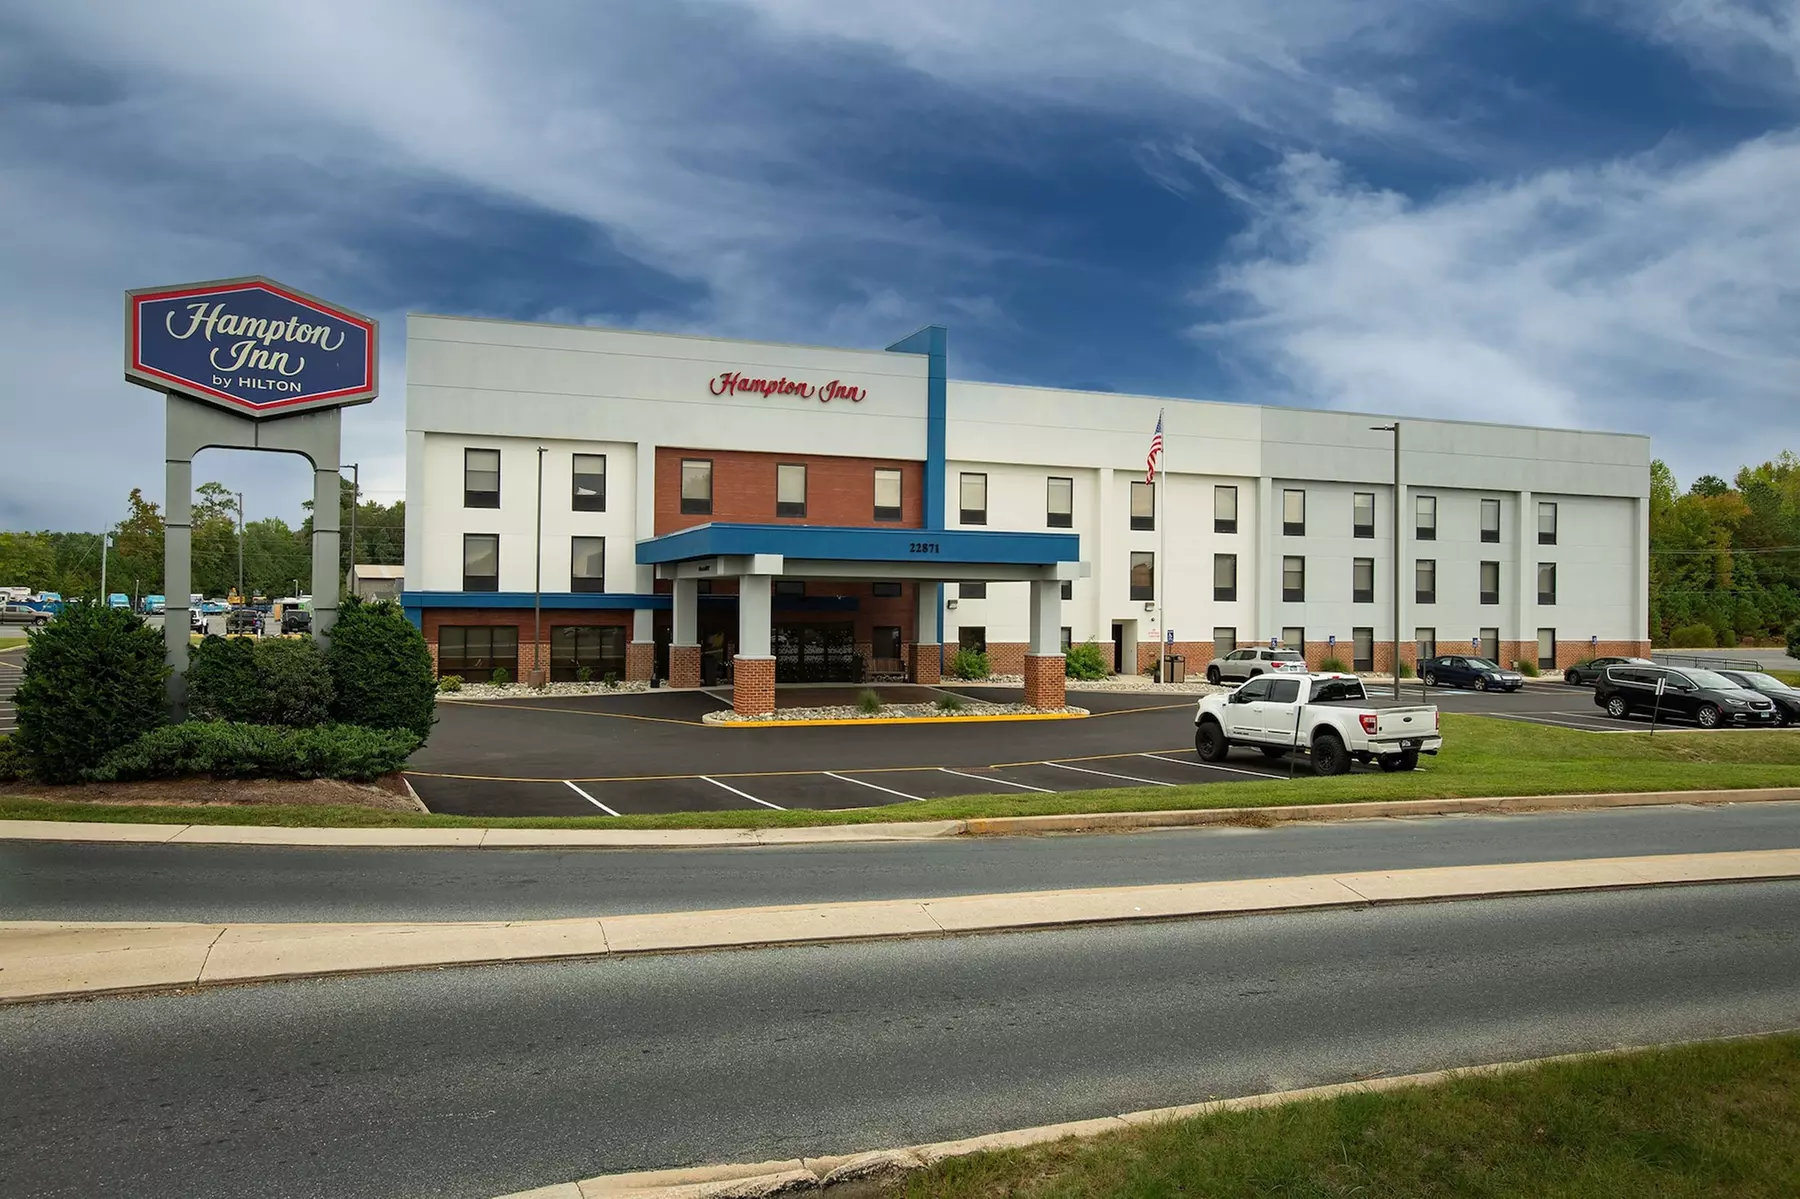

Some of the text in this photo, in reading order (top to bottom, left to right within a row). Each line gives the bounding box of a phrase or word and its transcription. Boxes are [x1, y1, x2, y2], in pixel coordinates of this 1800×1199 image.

[165, 302, 345, 351] Hampton
[209, 340, 305, 376] Inn
[212, 375, 302, 393] by HILTON
[709, 371, 866, 403] Hampton Inn
[909, 542, 940, 554] 22871
